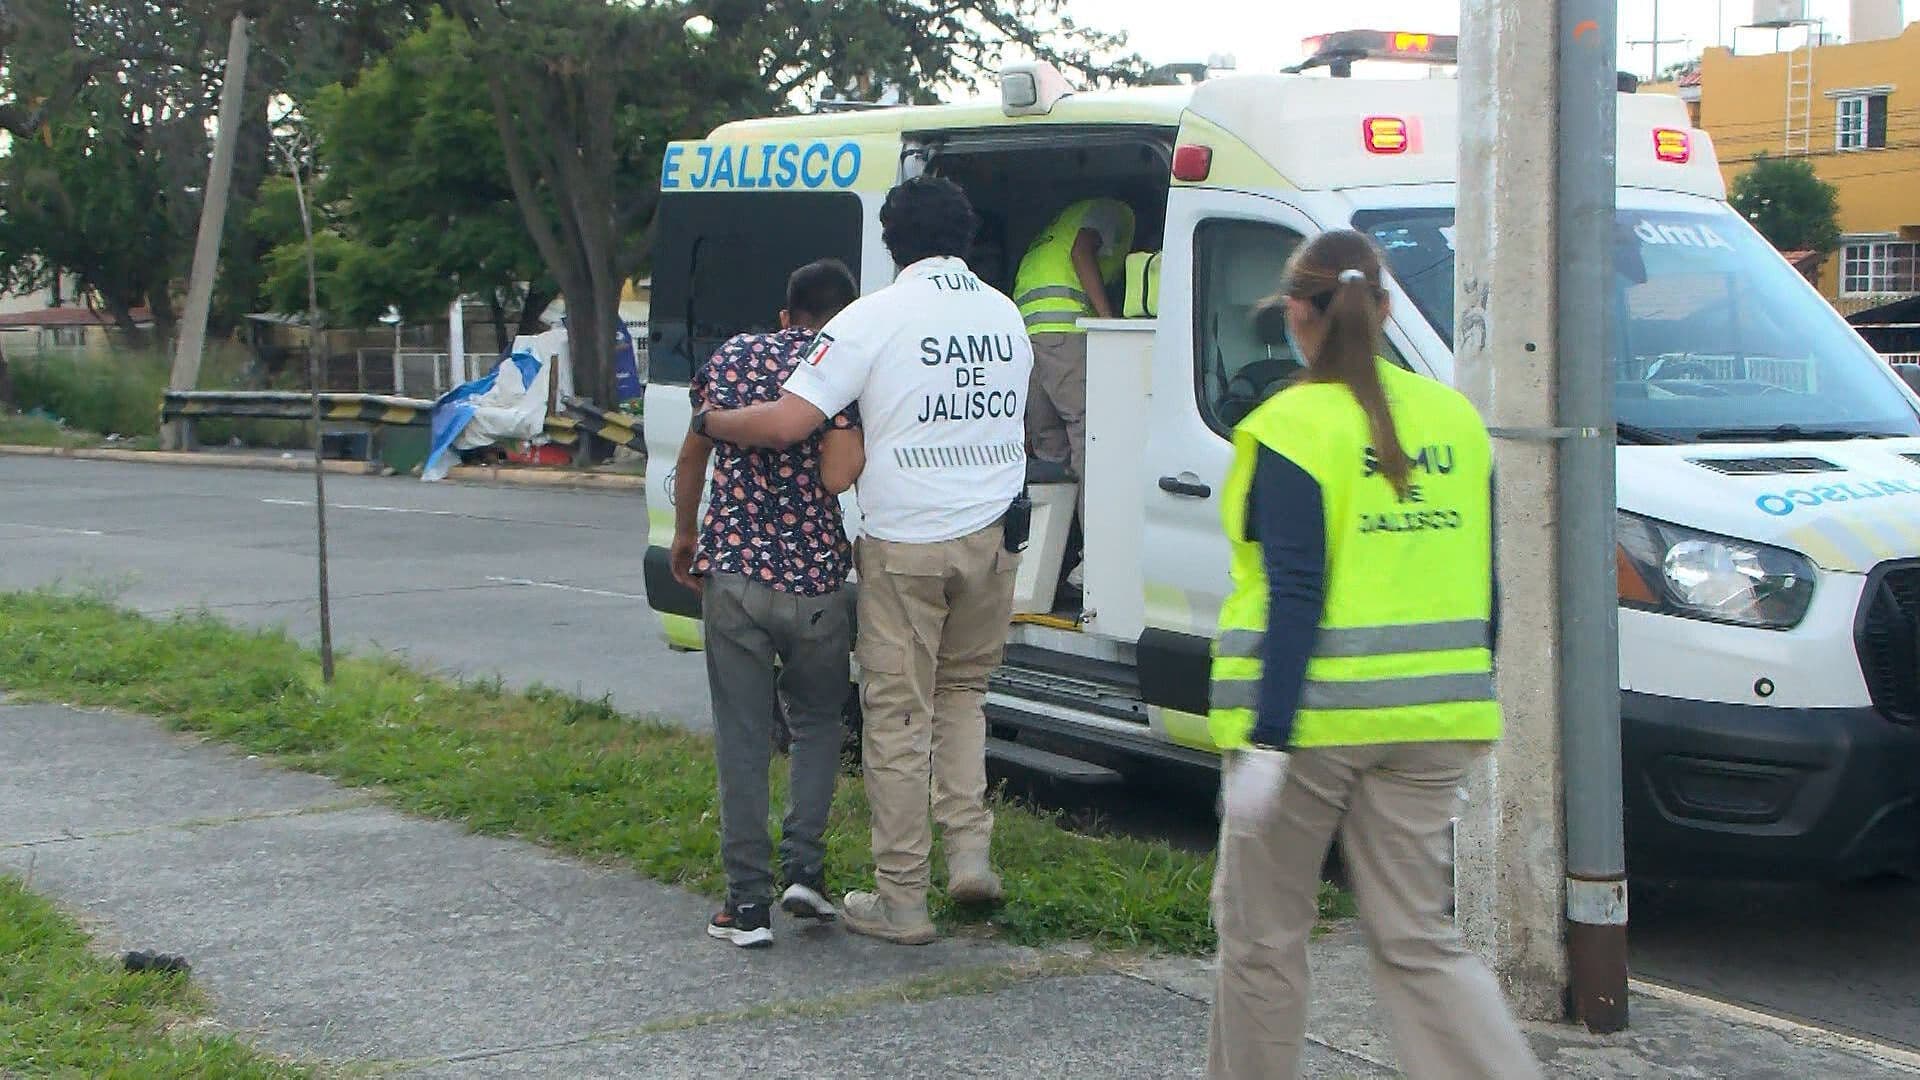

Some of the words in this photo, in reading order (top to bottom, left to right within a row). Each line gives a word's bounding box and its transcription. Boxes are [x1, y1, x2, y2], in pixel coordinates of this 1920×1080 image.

[690, 142, 861, 189] JALISCO
[928, 273, 980, 292] TUM
[920, 334, 1013, 366] SAMU
[956, 367, 986, 388] DE
[918, 390, 1016, 423] JALISCO
[1362, 446, 1453, 477] SMU
